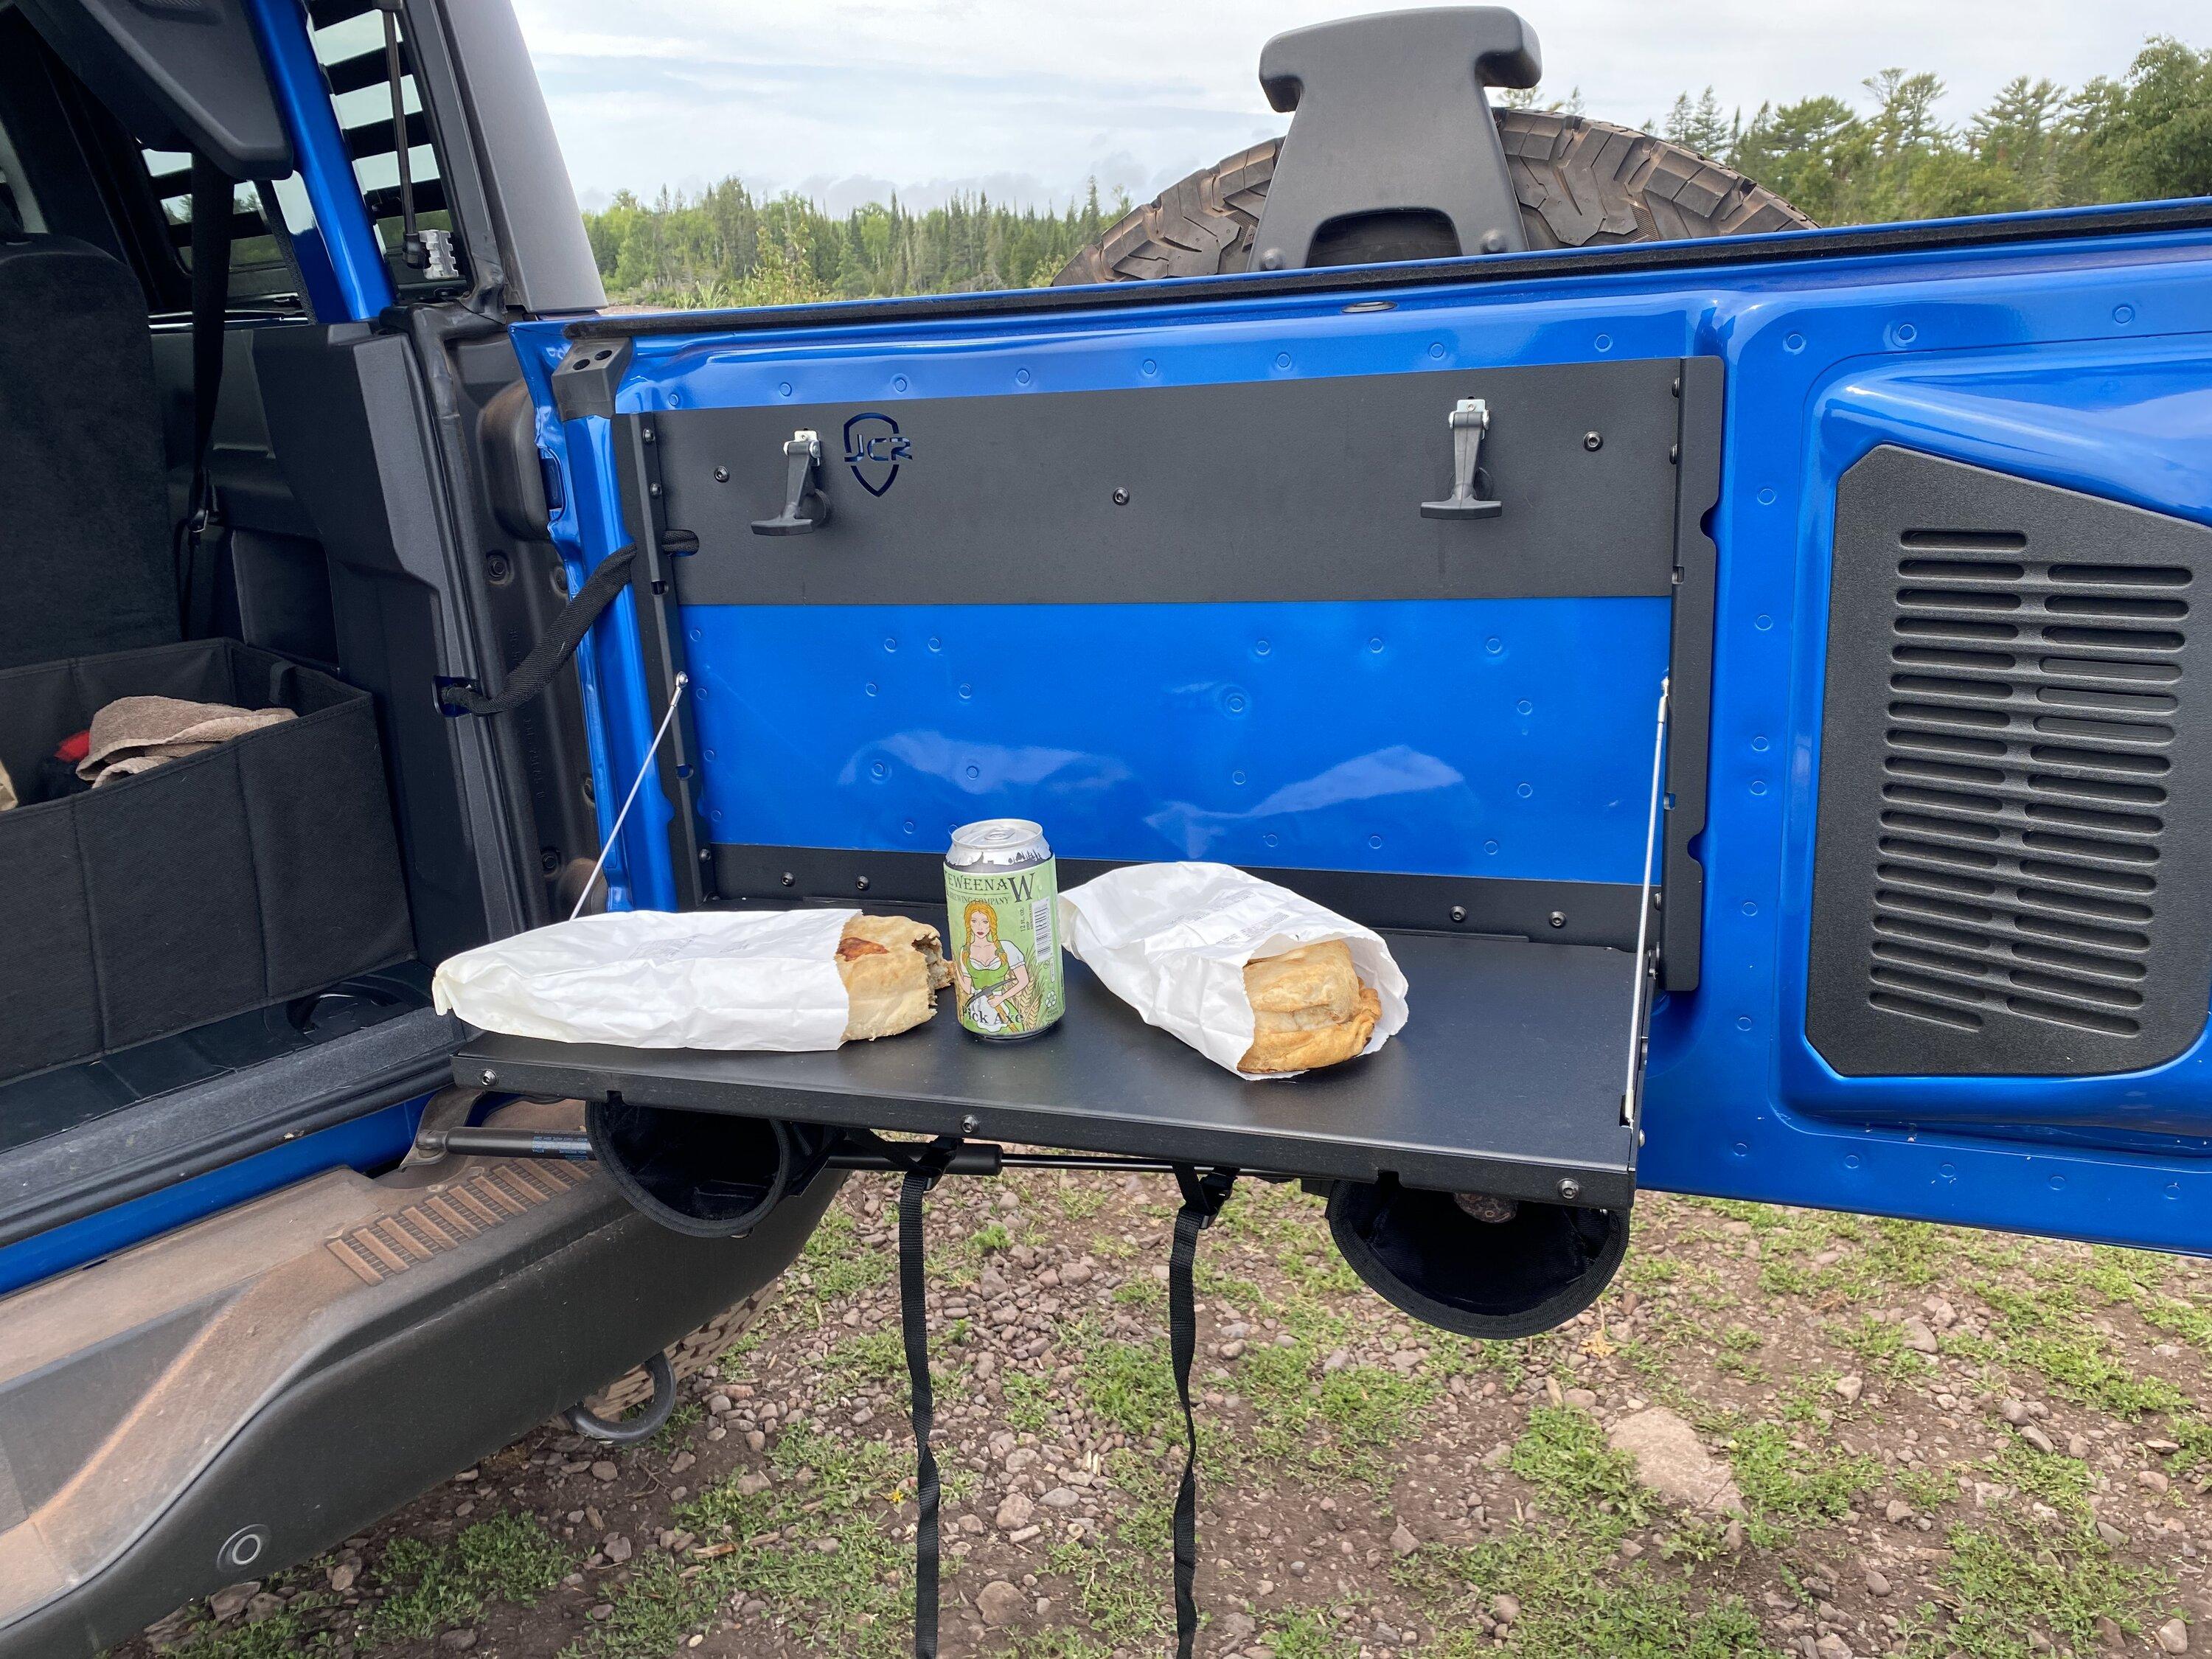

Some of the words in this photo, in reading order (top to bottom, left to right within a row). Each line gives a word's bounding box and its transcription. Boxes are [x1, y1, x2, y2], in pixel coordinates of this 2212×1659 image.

[844, 434, 913, 462] JCR
[975, 896, 1009, 906] COMPANY
[961, 1005, 989, 1023] Pick
[993, 1012, 1024, 1024] Axe
